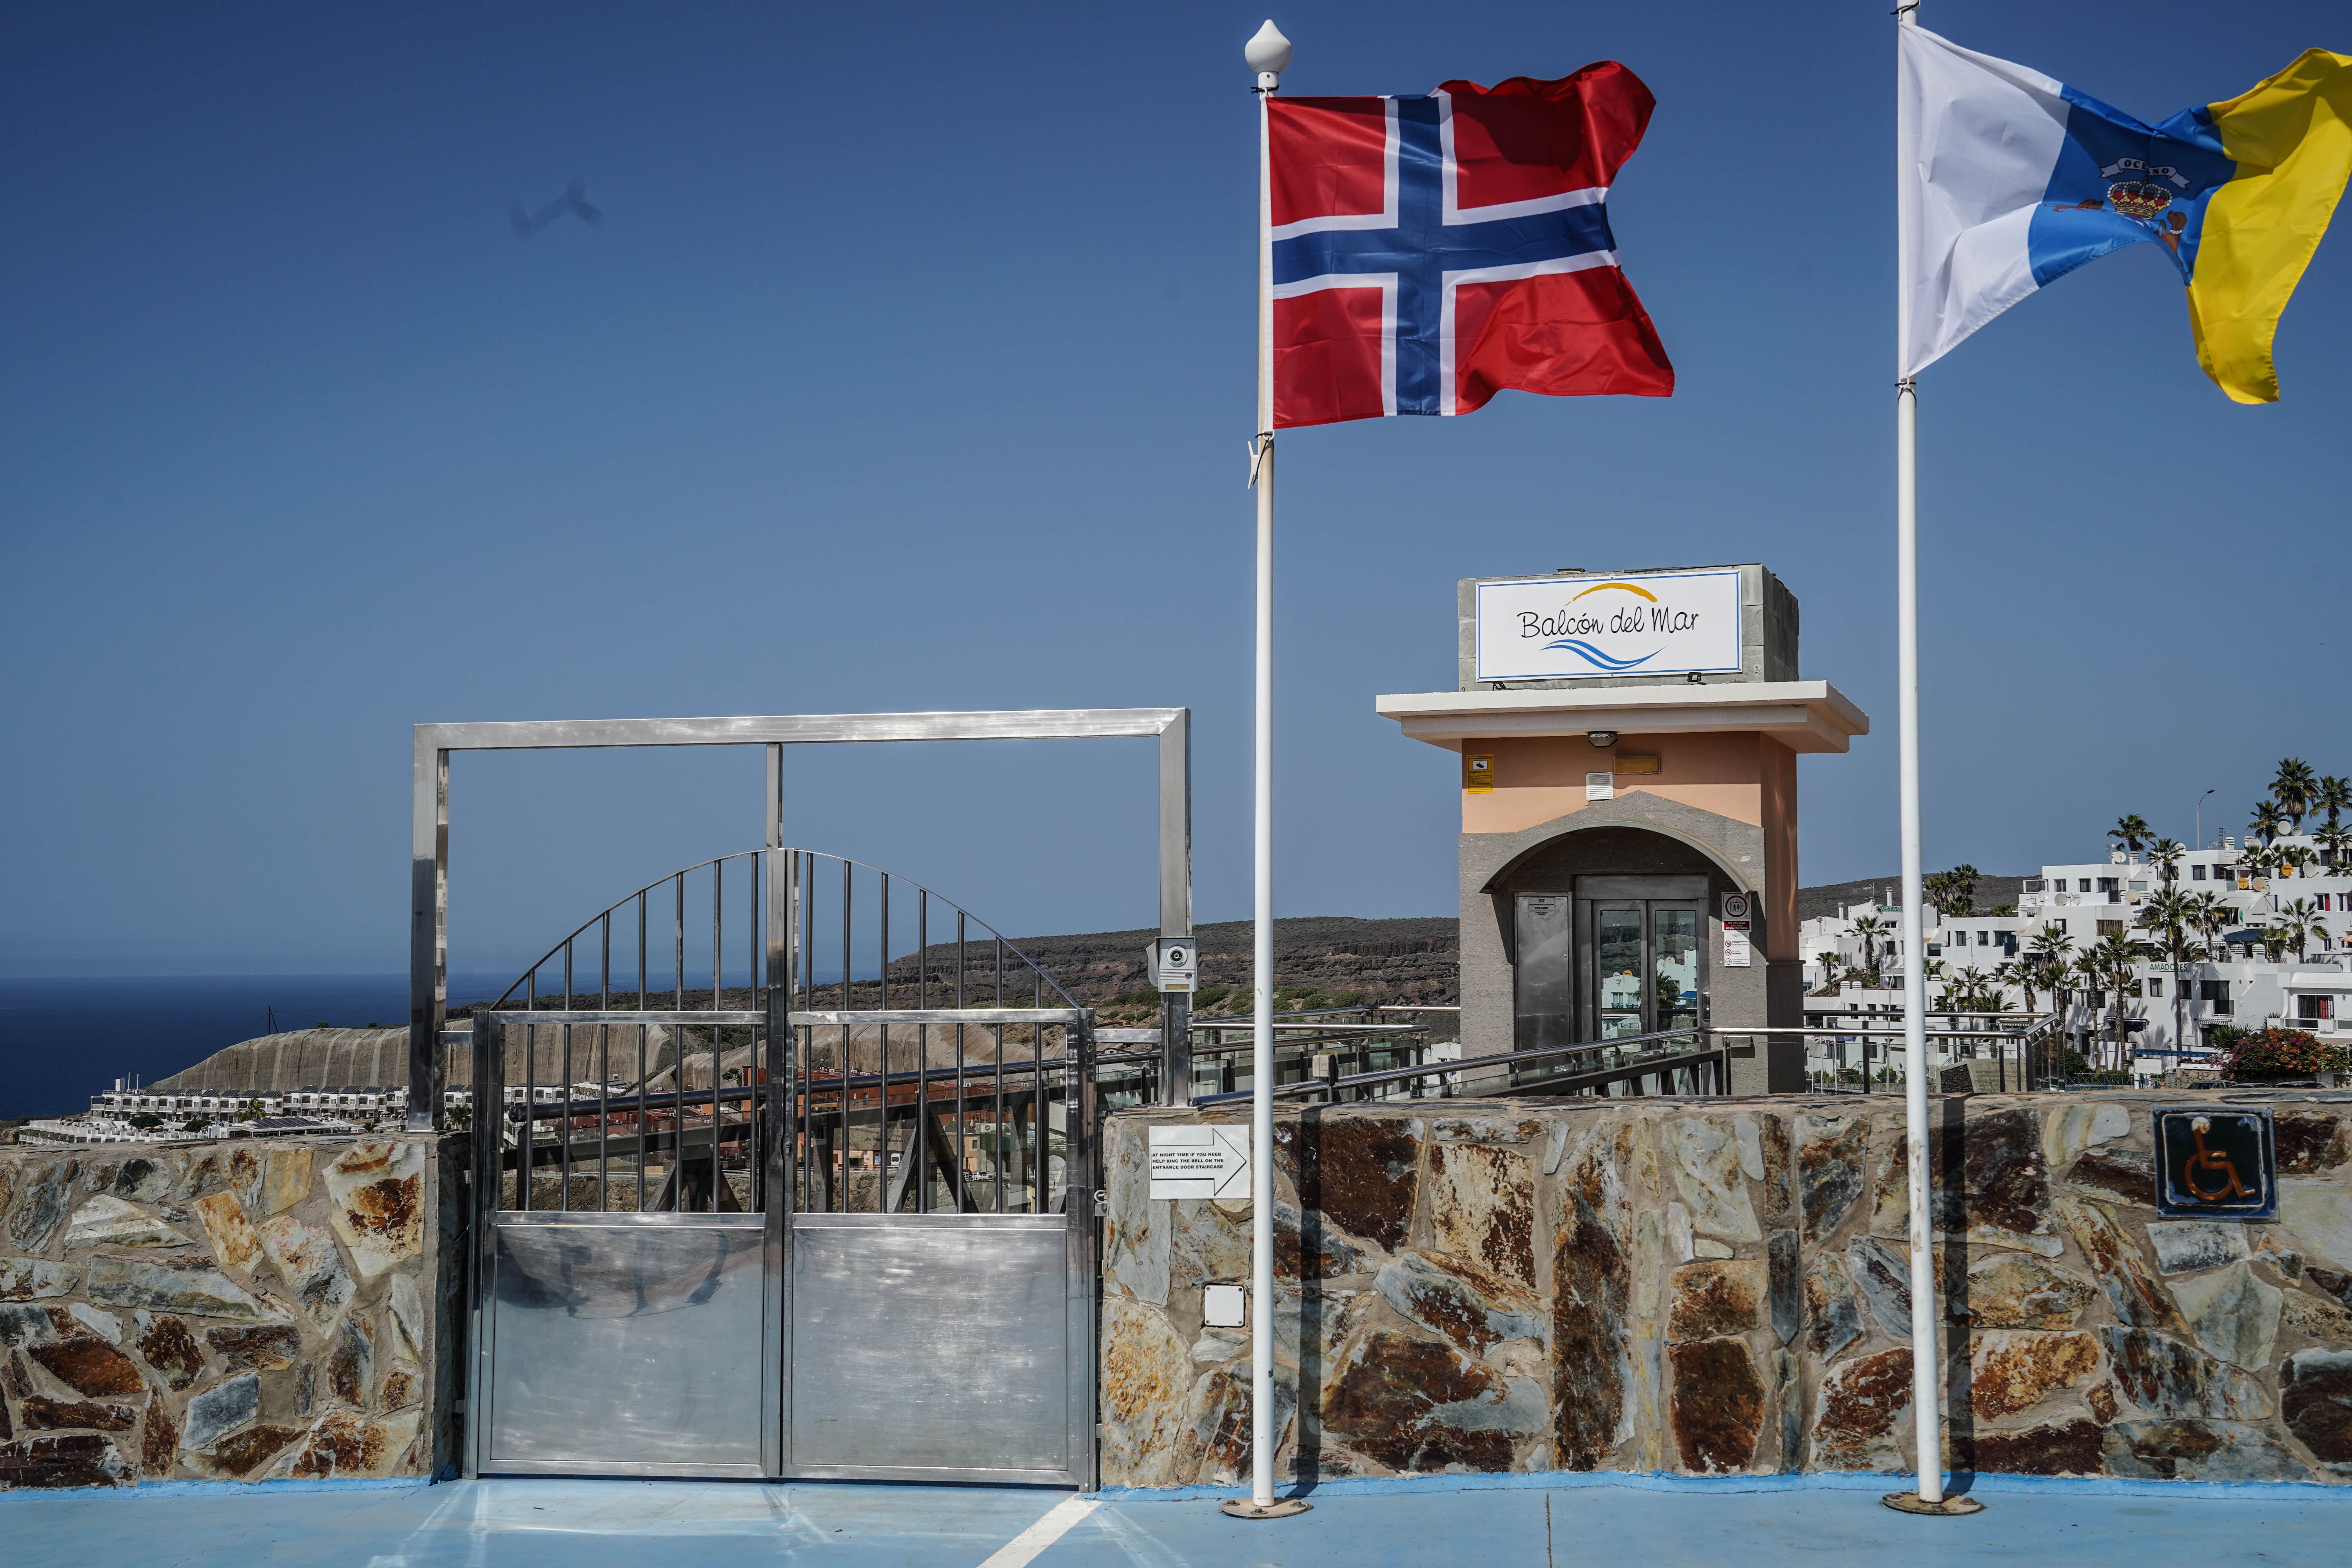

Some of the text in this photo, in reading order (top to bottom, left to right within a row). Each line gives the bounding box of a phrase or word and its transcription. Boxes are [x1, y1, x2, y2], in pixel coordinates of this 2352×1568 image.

[2124, 160, 2169, 174] OCEANO
[1517, 606, 1699, 638] Balcón del Mar
